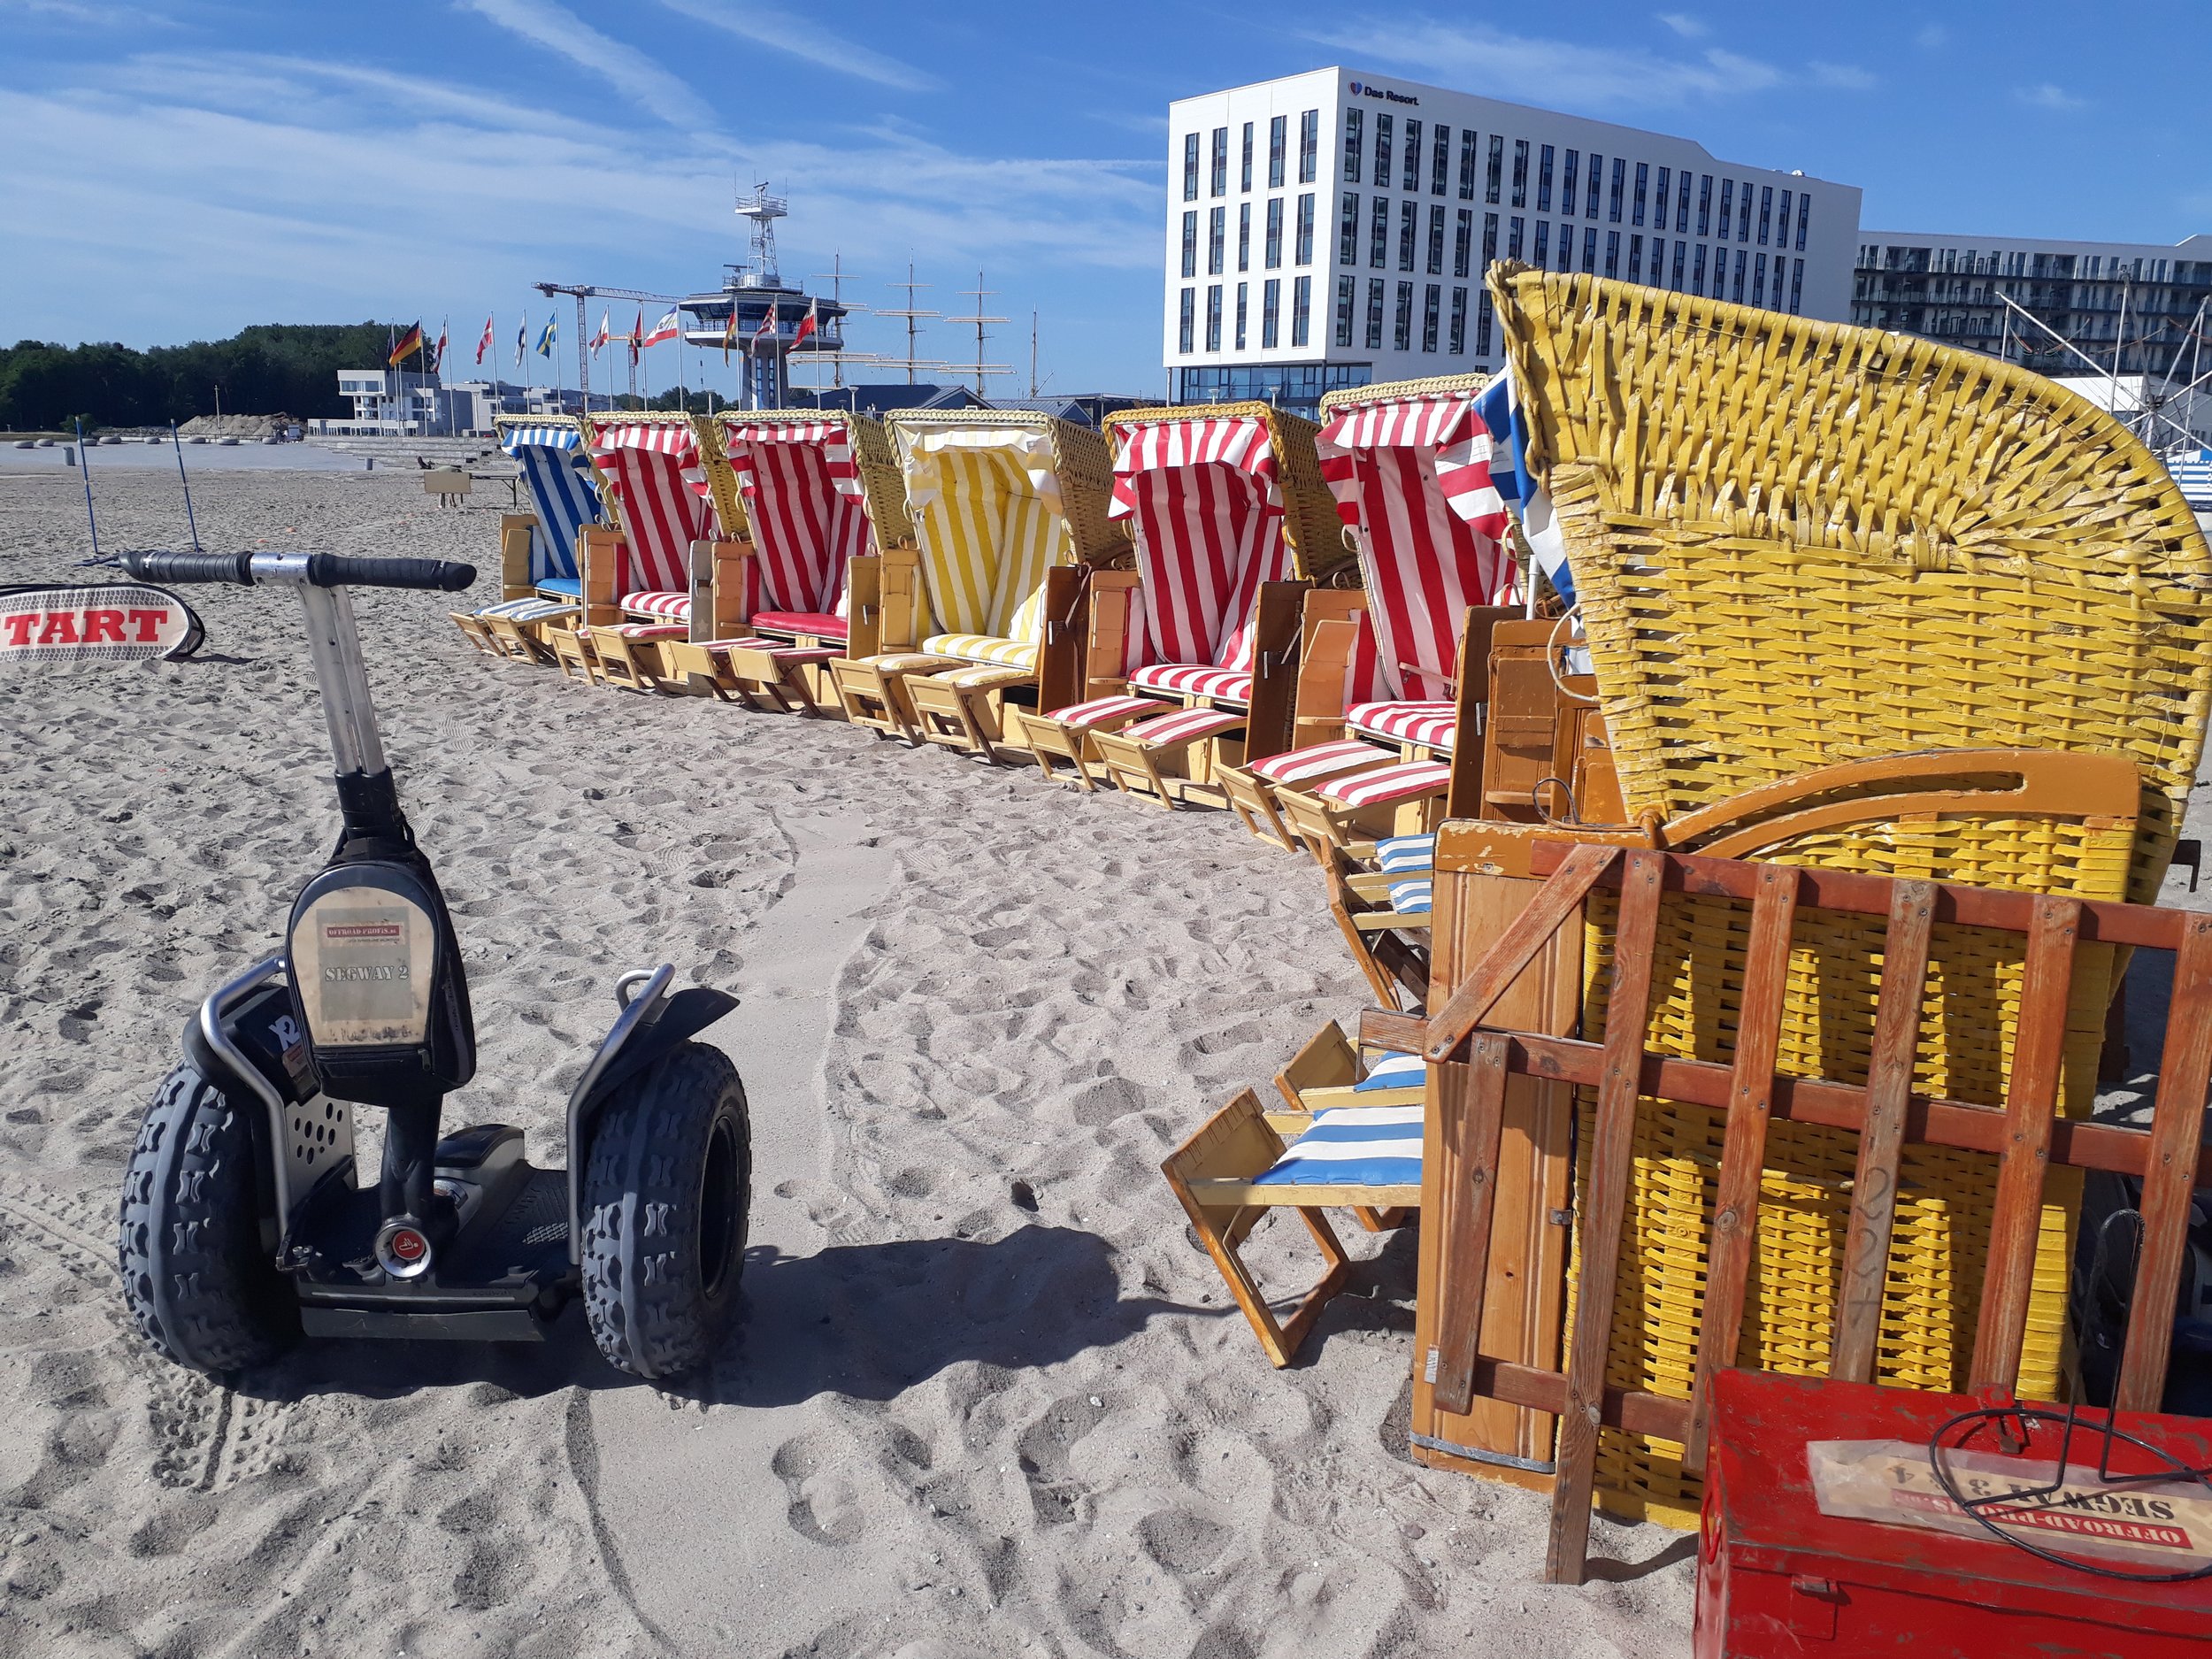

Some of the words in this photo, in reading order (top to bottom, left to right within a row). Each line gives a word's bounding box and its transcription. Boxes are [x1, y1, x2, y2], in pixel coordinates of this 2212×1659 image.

[1363, 86, 1385, 99] Das
[325, 965, 395, 982] SEGWAY
[398, 964, 409, 980] 2
[1892, 1465, 1915, 1484] 4
[1969, 1479, 1992, 1496] 3
